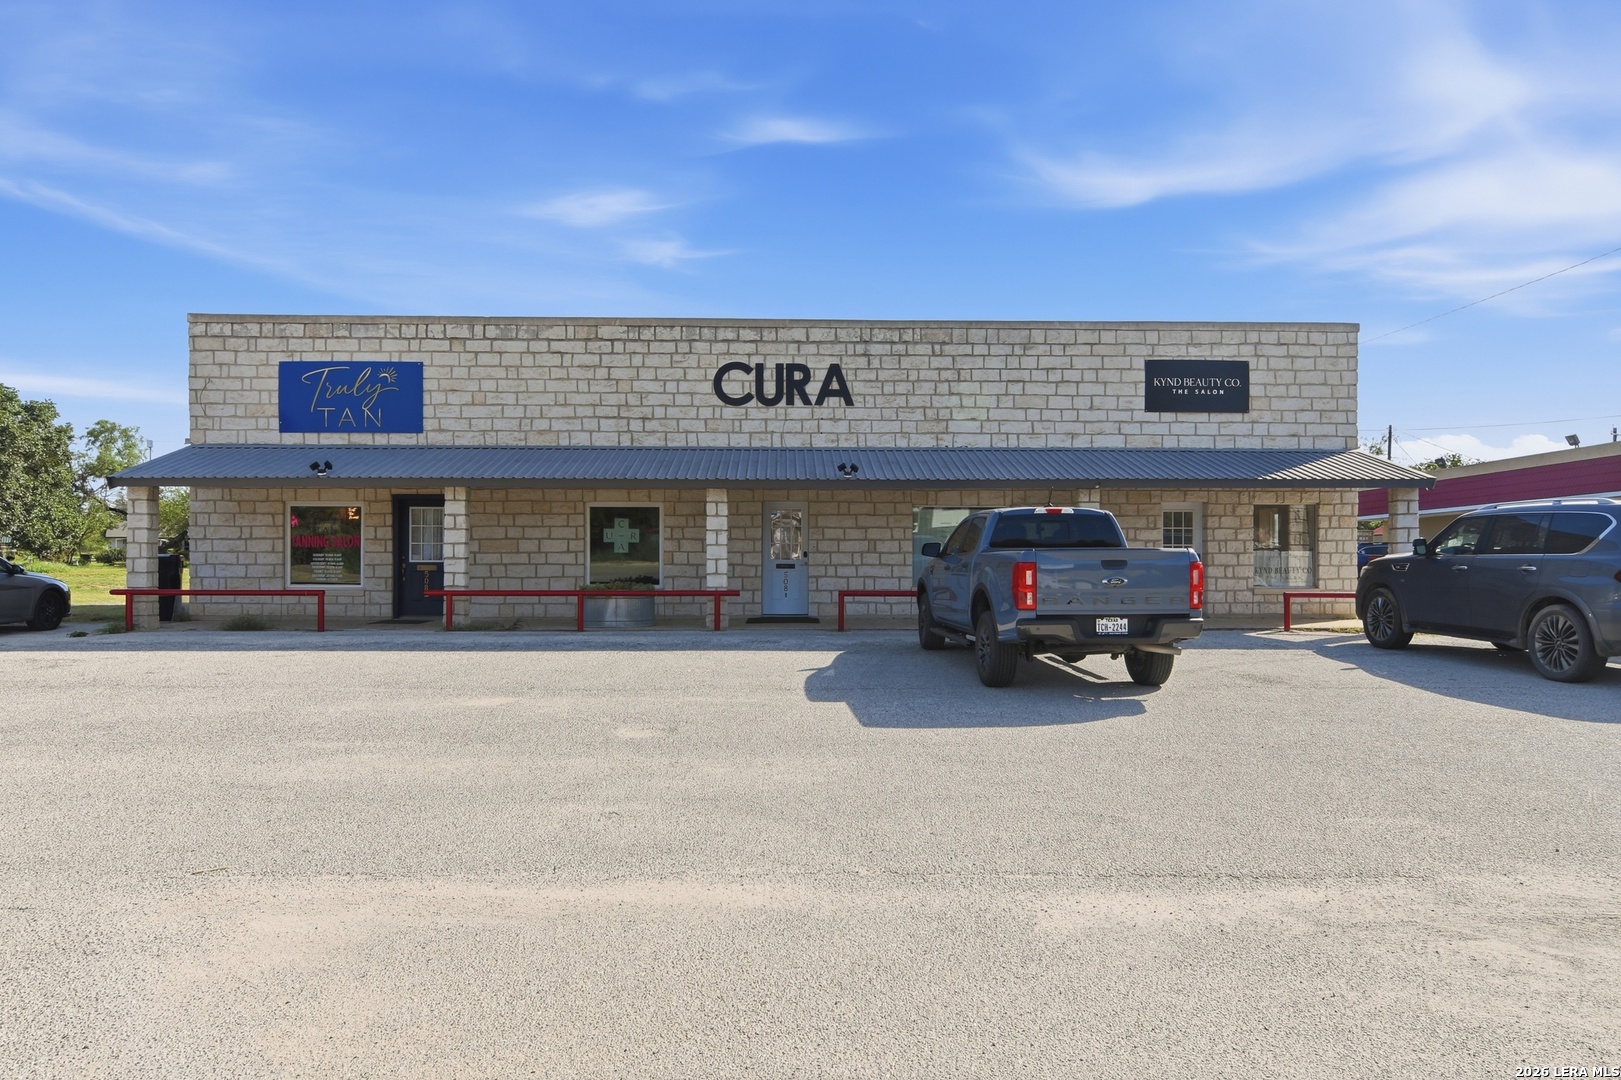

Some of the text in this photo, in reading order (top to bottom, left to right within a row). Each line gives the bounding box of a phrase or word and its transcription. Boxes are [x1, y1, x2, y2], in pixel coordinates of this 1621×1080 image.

[301, 366, 399, 413] Truly
[714, 361, 854, 406] CURA
[1153, 377, 1242, 388] KYND BEAUTY CO.
[317, 407, 381, 427] TAN
[292, 534, 361, 548] TANNING SALON
[1254, 566, 1273, 574] KYND
[1042, 596, 1186, 605] RANGER
